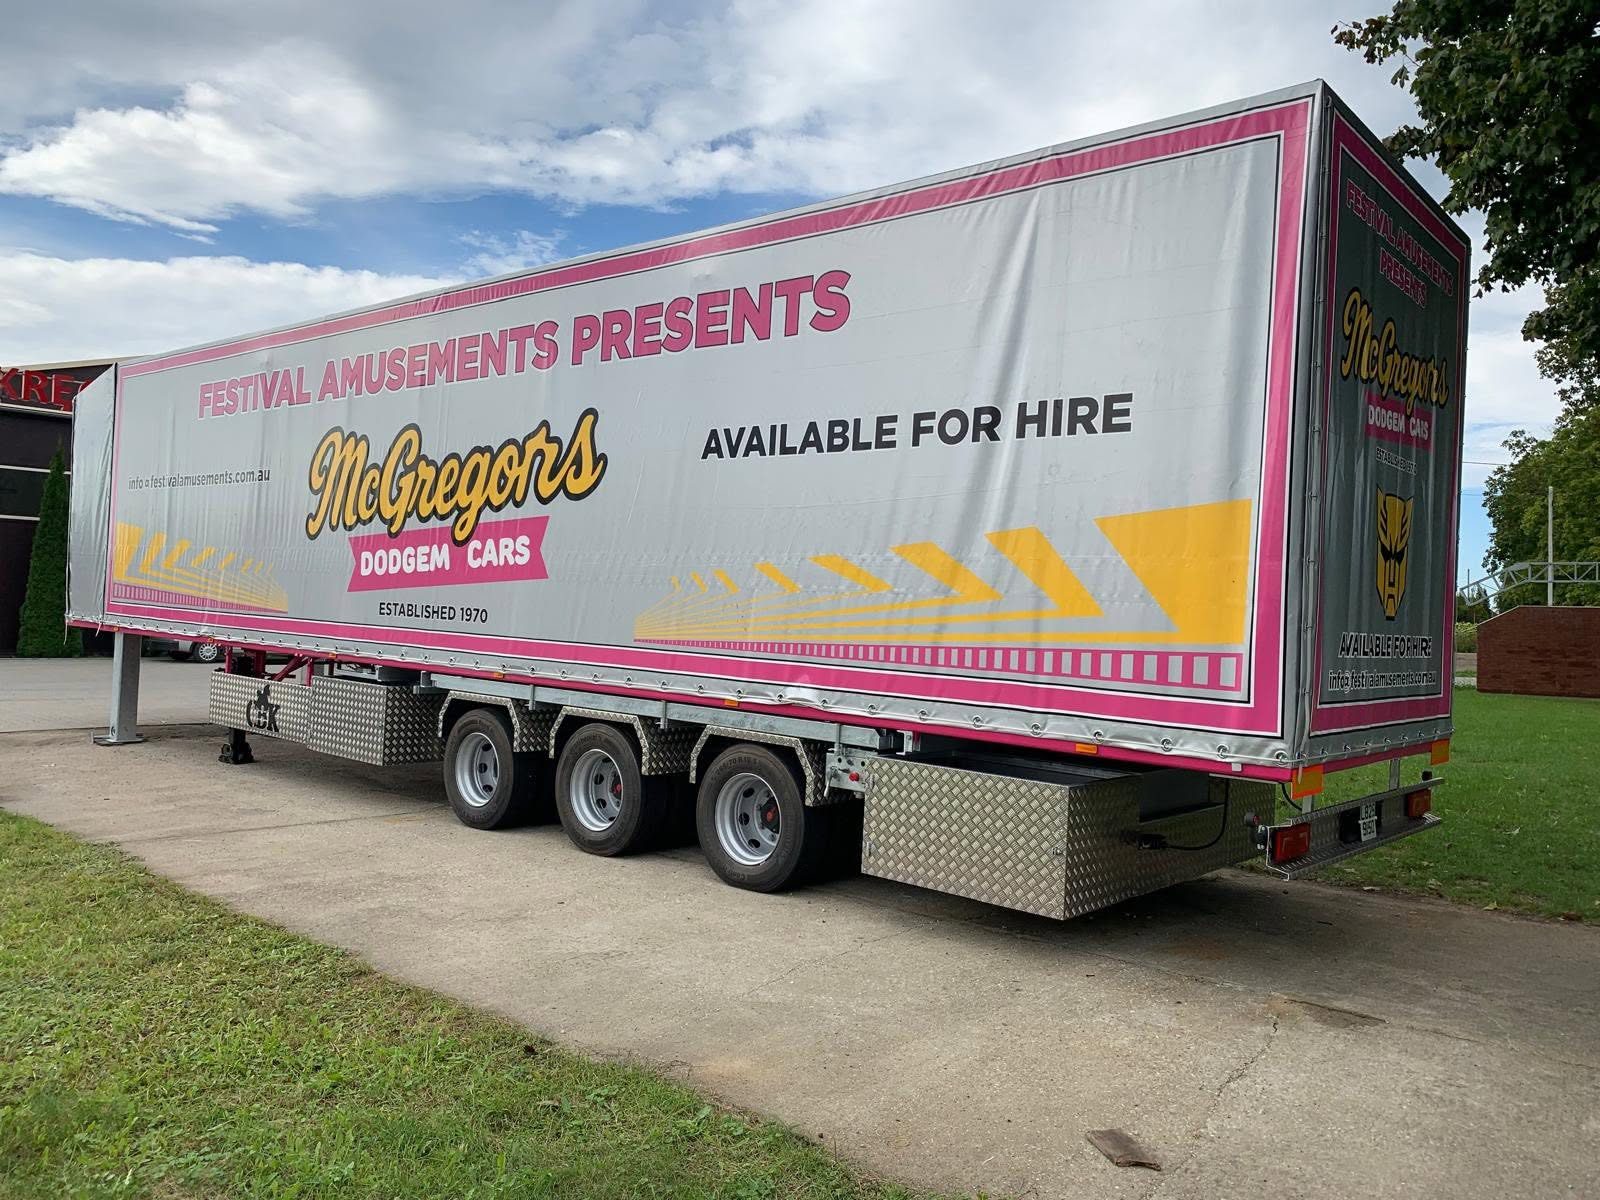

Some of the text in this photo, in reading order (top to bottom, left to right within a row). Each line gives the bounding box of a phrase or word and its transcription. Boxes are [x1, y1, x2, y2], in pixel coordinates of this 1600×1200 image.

[1346, 178, 1396, 248] FESTIVAL
[1380, 246, 1427, 309] PRESENTS
[198, 268, 853, 420] FESTIVAL AMUSEMENTS PRESENTS
[1340, 286, 1449, 417] McGregors
[700, 392, 1134, 460] AVAILABLE FOR HIRE
[1367, 404, 1406, 434] DODGEM
[306, 407, 608, 547] McGregors
[360, 535, 531, 577] DODGEM CARS
[378, 602, 488, 624] ESTABLISHED 1970
[1338, 632, 1392, 658] AVAILABLE
[1393, 634, 1411, 658] FOR
